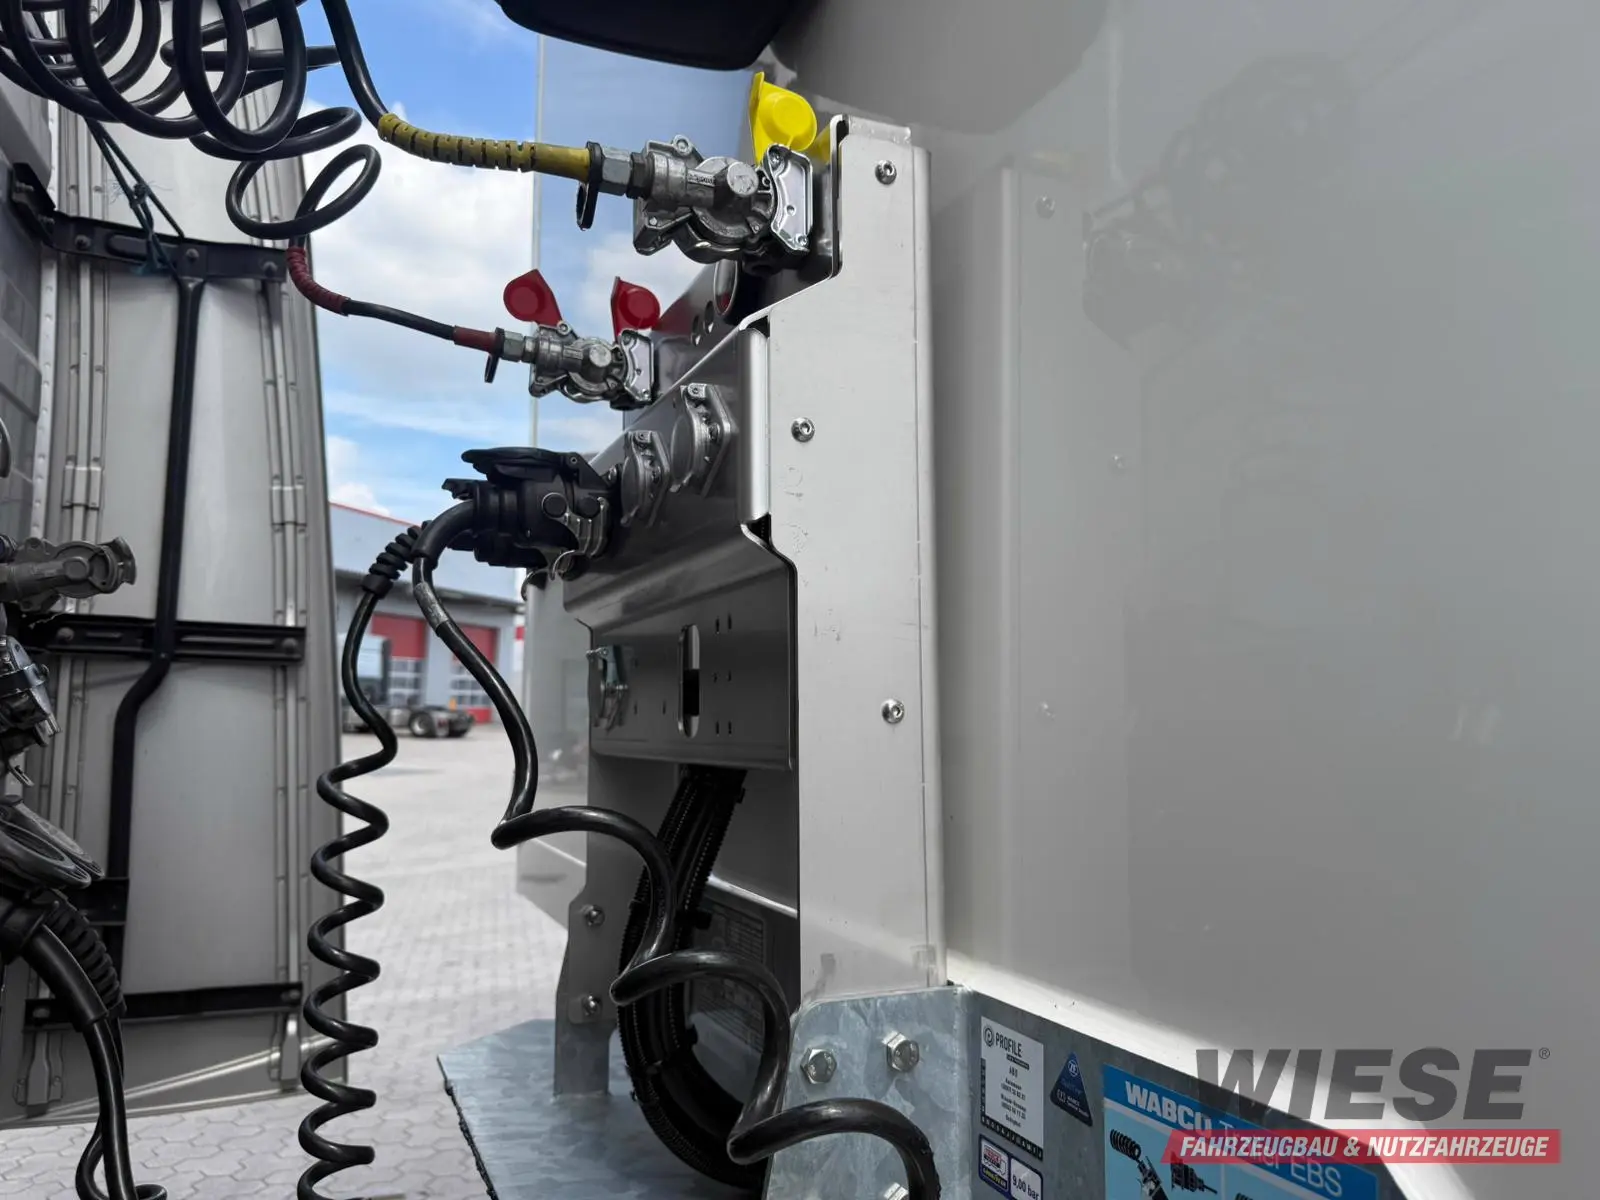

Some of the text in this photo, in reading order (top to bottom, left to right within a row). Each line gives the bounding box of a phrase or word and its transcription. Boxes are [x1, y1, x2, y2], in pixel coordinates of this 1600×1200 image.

[995, 1032, 1022, 1058] PROFILE
[1125, 1080, 1212, 1139] WABCO
[1291, 1156, 1342, 1197] EBS
